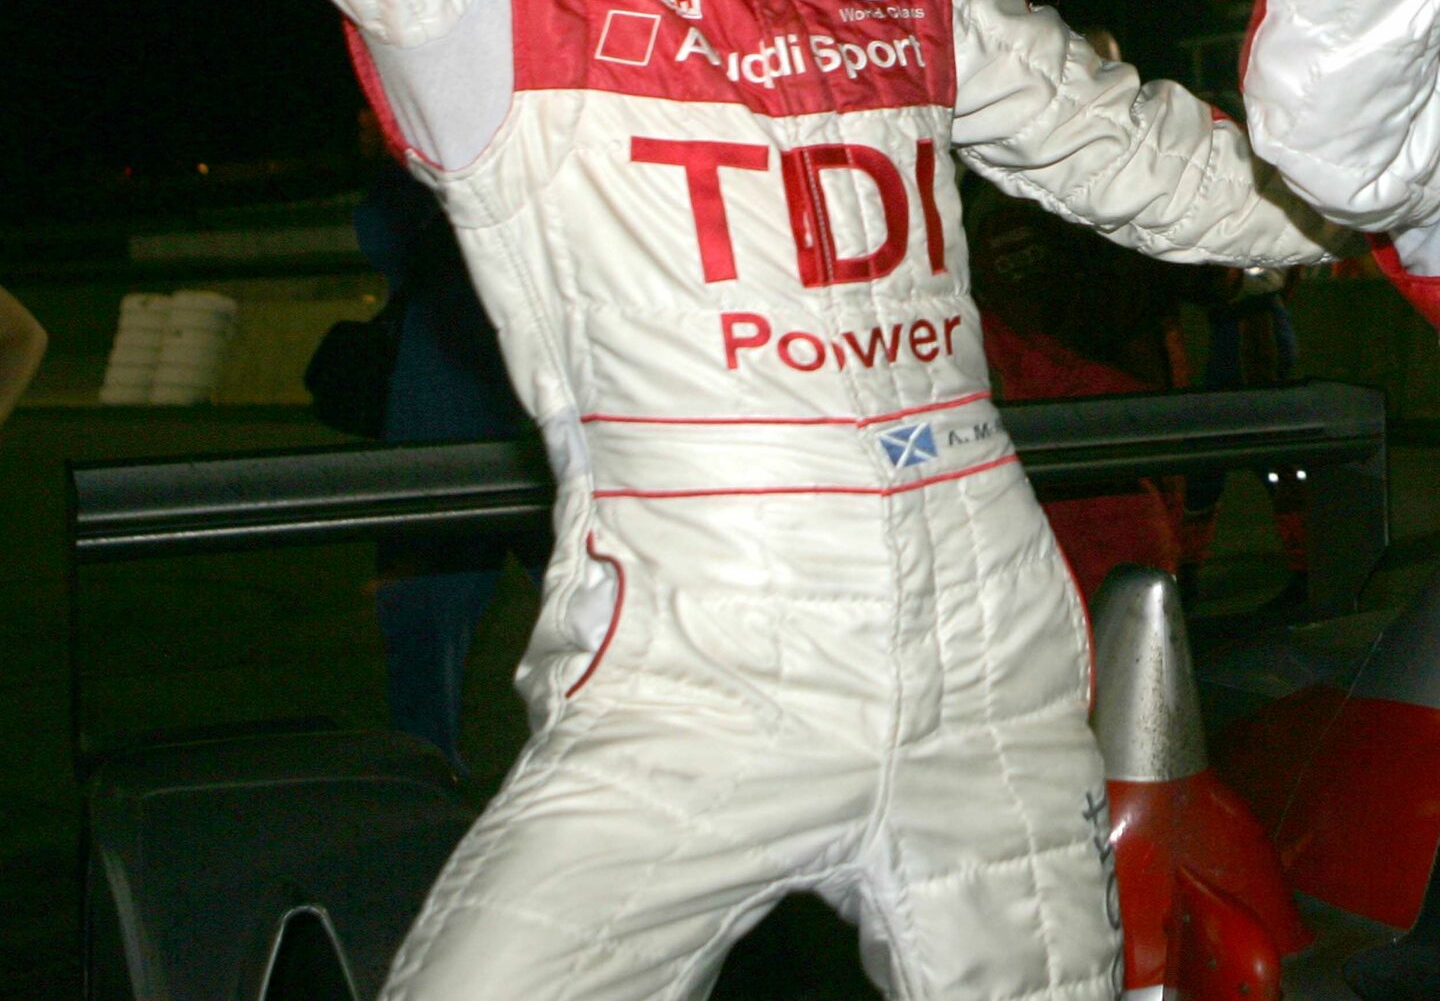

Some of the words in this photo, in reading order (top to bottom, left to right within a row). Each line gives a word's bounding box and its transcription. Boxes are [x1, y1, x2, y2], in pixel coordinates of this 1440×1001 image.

[810, 35, 927, 79] Sport
[630, 136, 948, 289] TDI
[720, 310, 962, 373] Power
